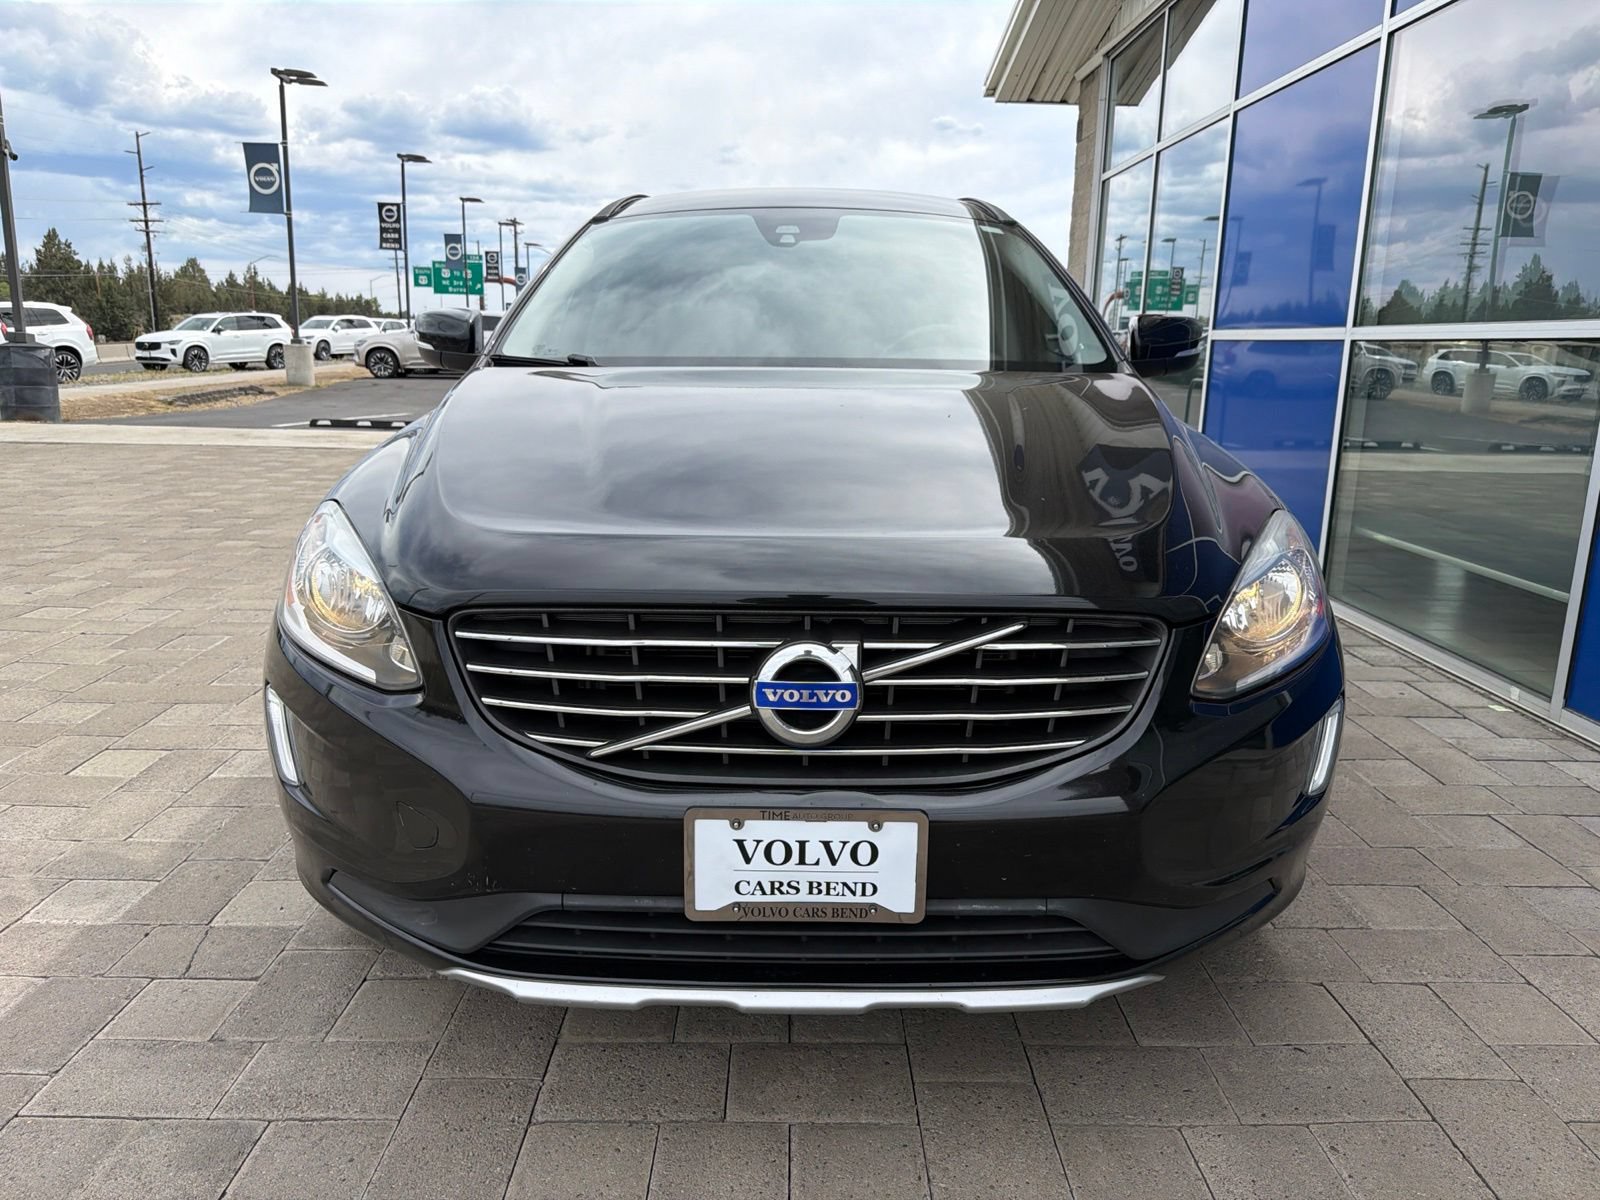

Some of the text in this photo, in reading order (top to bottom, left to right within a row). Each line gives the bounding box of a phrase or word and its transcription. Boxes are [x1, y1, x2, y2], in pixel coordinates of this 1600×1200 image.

[762, 689, 852, 703] VOLVO
[760, 811, 790, 821] TIME
[733, 839, 879, 867] VOLVO
[734, 880, 878, 897] CARS BEND
[742, 906, 868, 919] VOLVO CARS BEND
